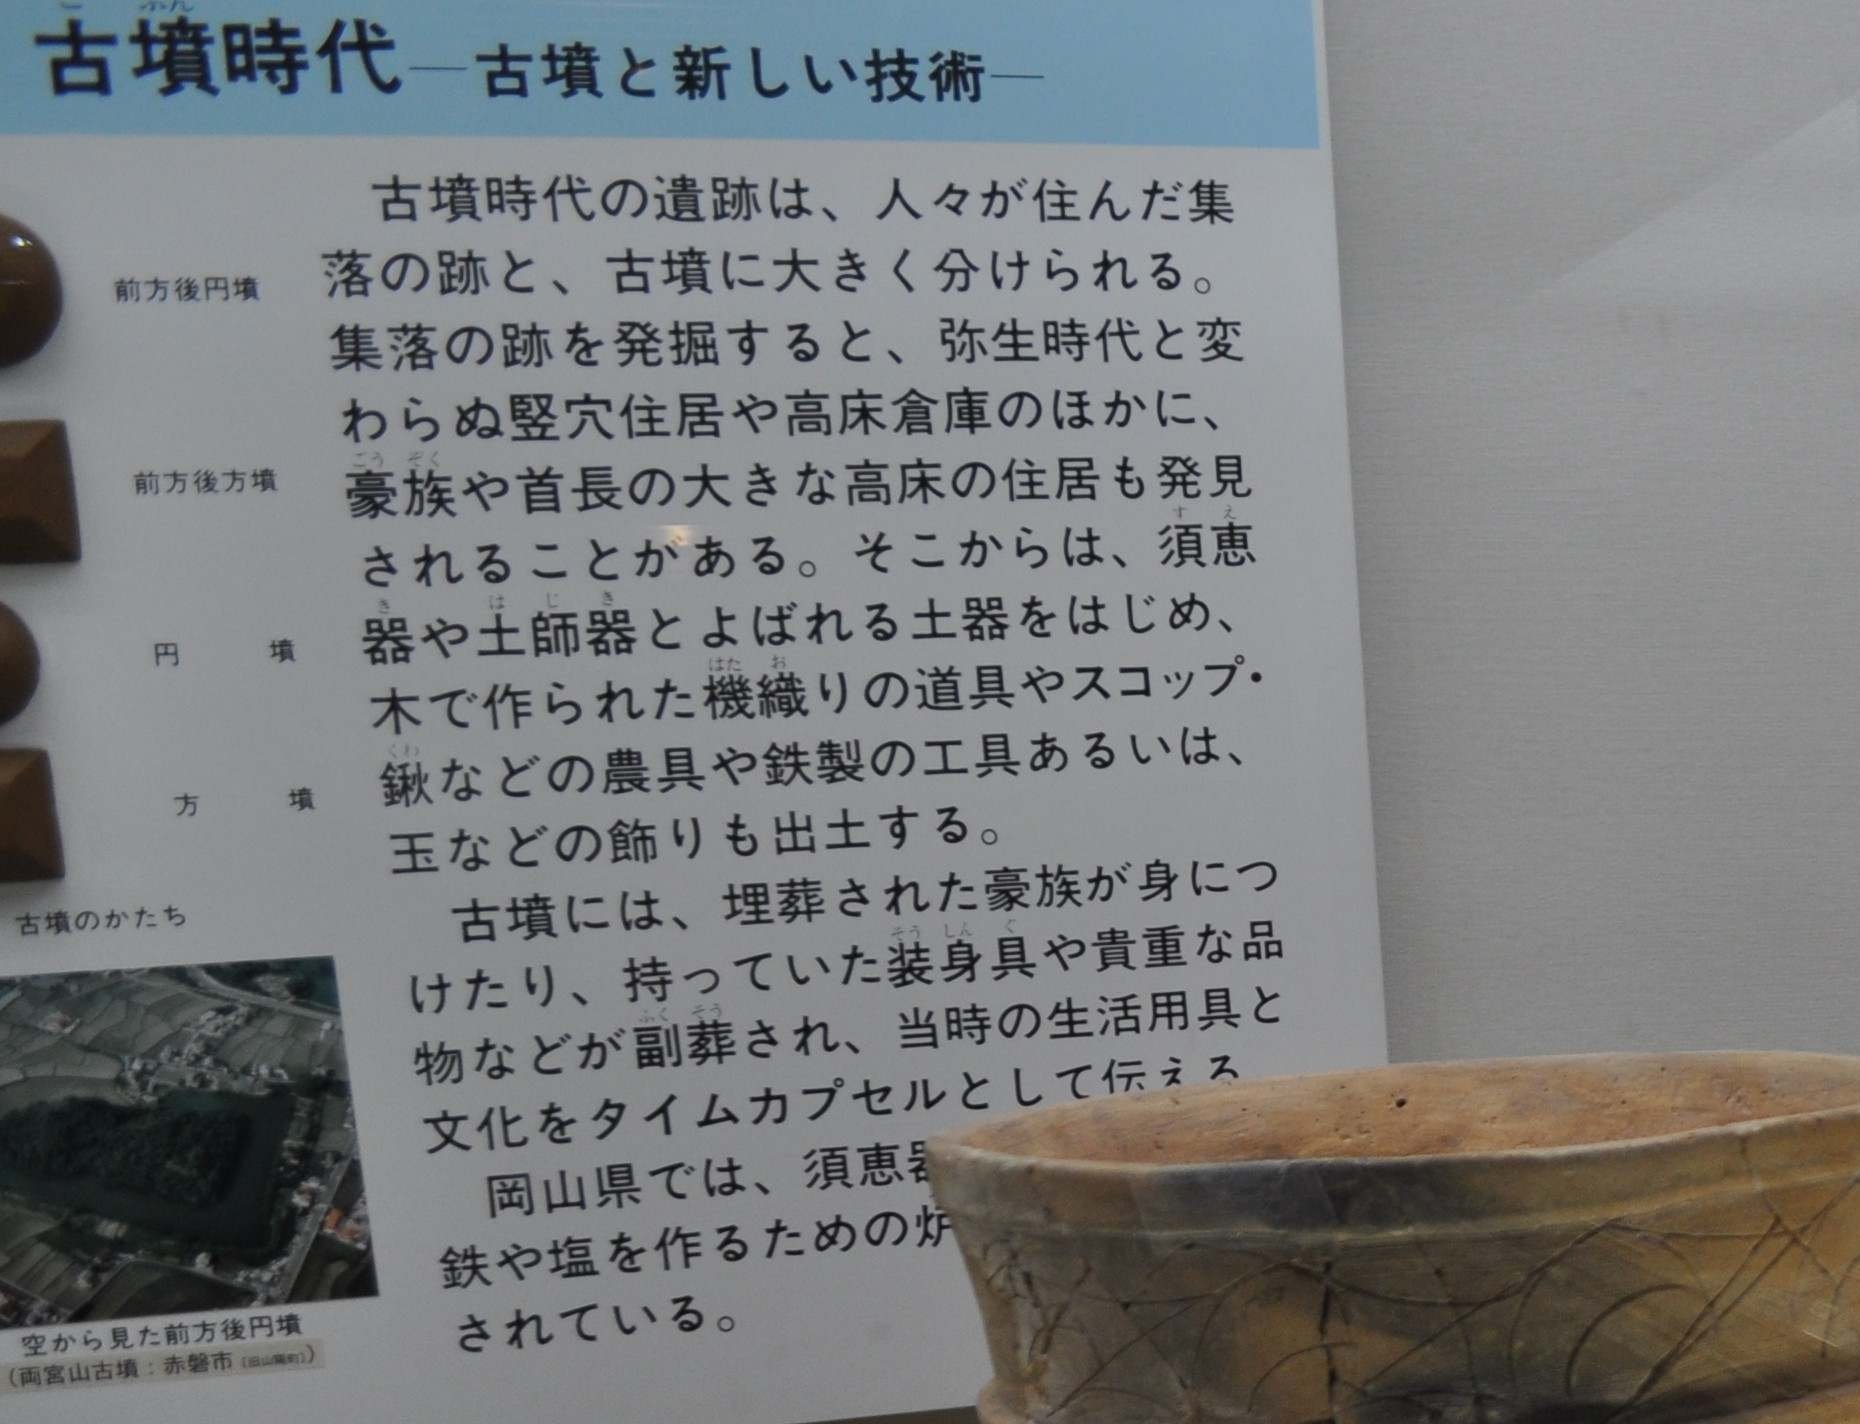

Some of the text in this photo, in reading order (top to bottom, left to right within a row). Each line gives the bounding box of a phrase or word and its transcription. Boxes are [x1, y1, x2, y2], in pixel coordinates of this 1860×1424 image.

[372, 174, 1233, 224] 古墳時代の遺跡は、人々が住んだ集
[113, 275, 260, 302] 前方後円墳
[322, 247, 1210, 297] 落の跡と、古墳に大きく分けられる。
[330, 317, 1243, 371] 集落の跡を発掘すると、弥生時代と変
[343, 386, 1217, 443] わらぬ竪穴住居や高床倉庫のほかに、
[133, 468, 278, 495] 前方後方墳
[346, 455, 1251, 519] 豪族や首長の大きな高床の住居も発見
[365, 522, 1256, 587] されることがある。そこからは、須恵
[363, 595, 1232, 665] 器や土師器とよばれる土器をはじめ、
[371, 655, 1262, 734] 木で作られた機織りの道具やスコップ・
[380, 729, 1241, 807] 鍬などの農具や鉄製の工具あるいは、
[390, 805, 997, 874] 玉などの飾りも出土する。
[15, 905, 188, 937] 古墳のかたち
[452, 859, 1277, 943] 古墳には、埋葬された豪族が身につ
[412, 921, 1283, 1013] けたり、持っていた装身具や貴重な品
[414, 987, 1279, 1085] 物などが副葬され、当時の生活用具と
[21, 1313, 303, 1357] 空から見た前方後円墳
[459, 1296, 734, 1352] されている。
